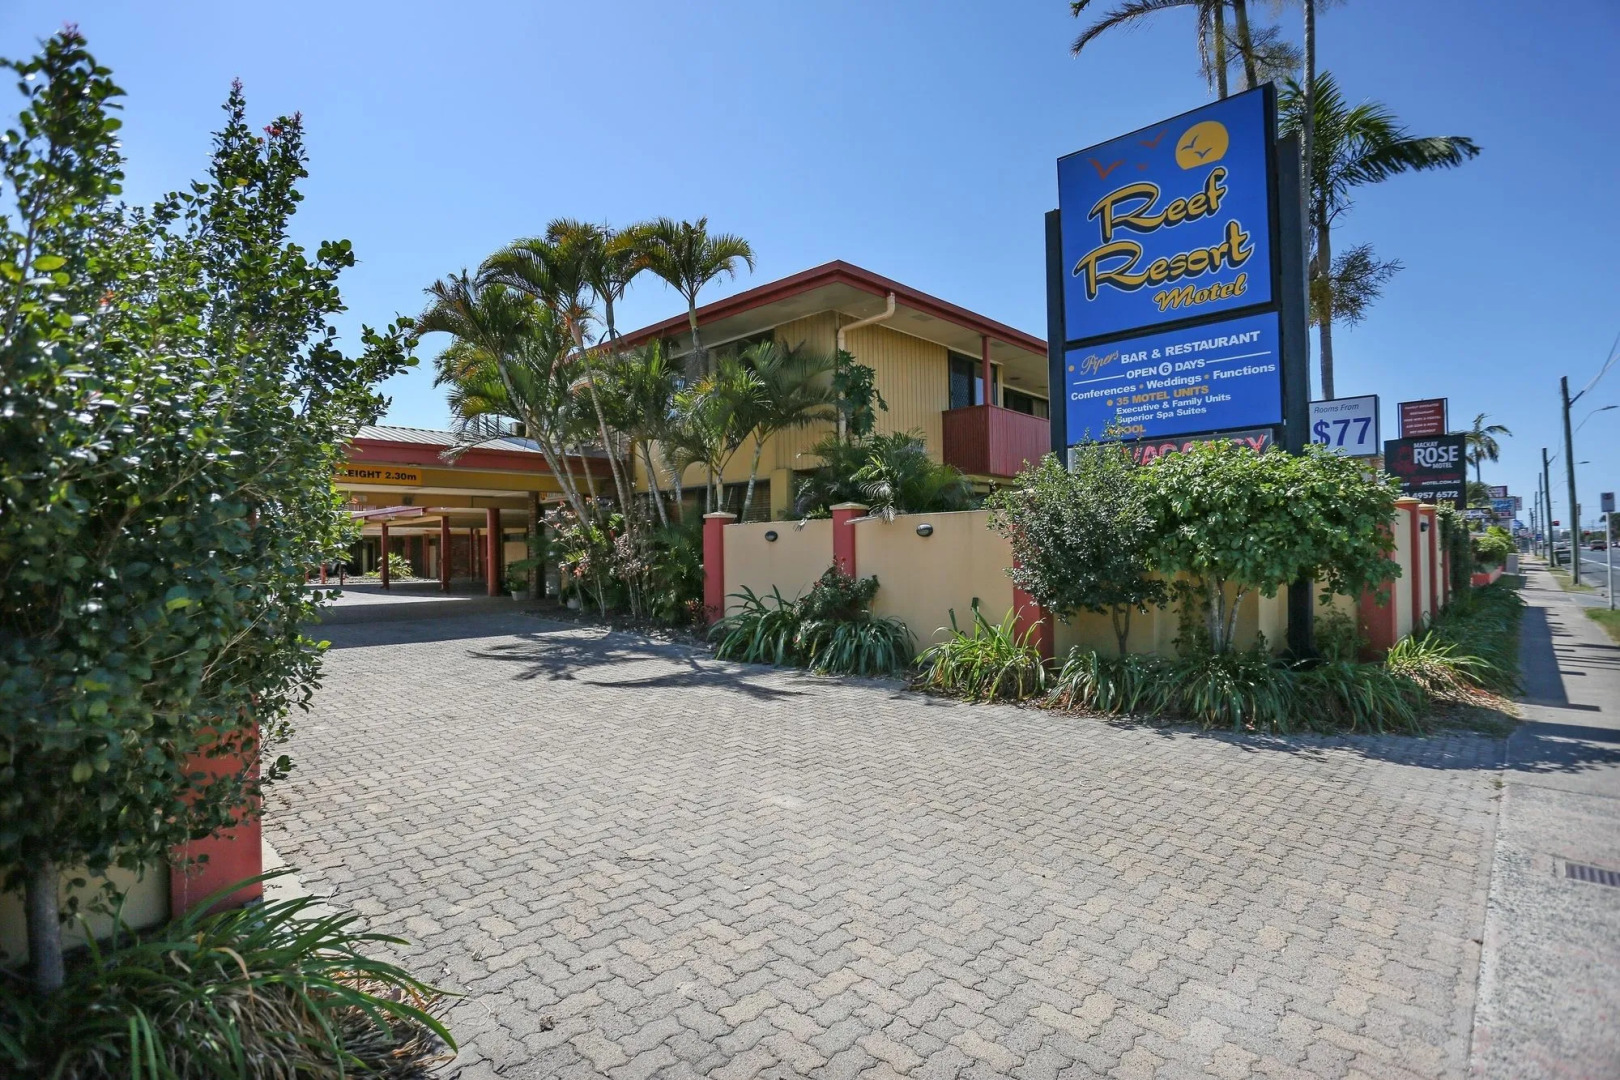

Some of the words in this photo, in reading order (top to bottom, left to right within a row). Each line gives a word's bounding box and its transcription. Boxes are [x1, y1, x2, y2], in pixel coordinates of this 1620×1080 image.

[1087, 166, 1228, 243] Reef
[1072, 218, 1255, 301] Resort
[1153, 273, 1247, 312] Motel
[1121, 351, 1147, 364] BAR
[1151, 349, 1161, 358] &
[1165, 331, 1260, 357] RESTAURANT
[1126, 367, 1157, 379] OPEN
[1175, 359, 1205, 372] DAYS
[1071, 384, 1136, 401] Conferences
[1146, 374, 1202, 389] Weddings
[1213, 362, 1276, 380] Functions
[1116, 403, 1159, 415] Executive
[1162, 401, 1169, 409] &
[1172, 397, 1202, 409] Family
[1205, 393, 1231, 403] Units
[1117, 397, 1129, 406] 35
[1132, 392, 1170, 404] MOTEL
[1173, 385, 1209, 398] UNITS
[1116, 413, 1154, 424] Superior
[1156, 411, 1174, 420] Spa
[1177, 406, 1206, 416] Suites
[1314, 406, 1338, 414] Rooms
[1340, 403, 1359, 411] From
[1312, 417, 1371, 446] $77
[1413, 445, 1458, 467] ROSE
[340, 469, 381, 478] EIGHT
[385, 472, 416, 480] 2.30m
